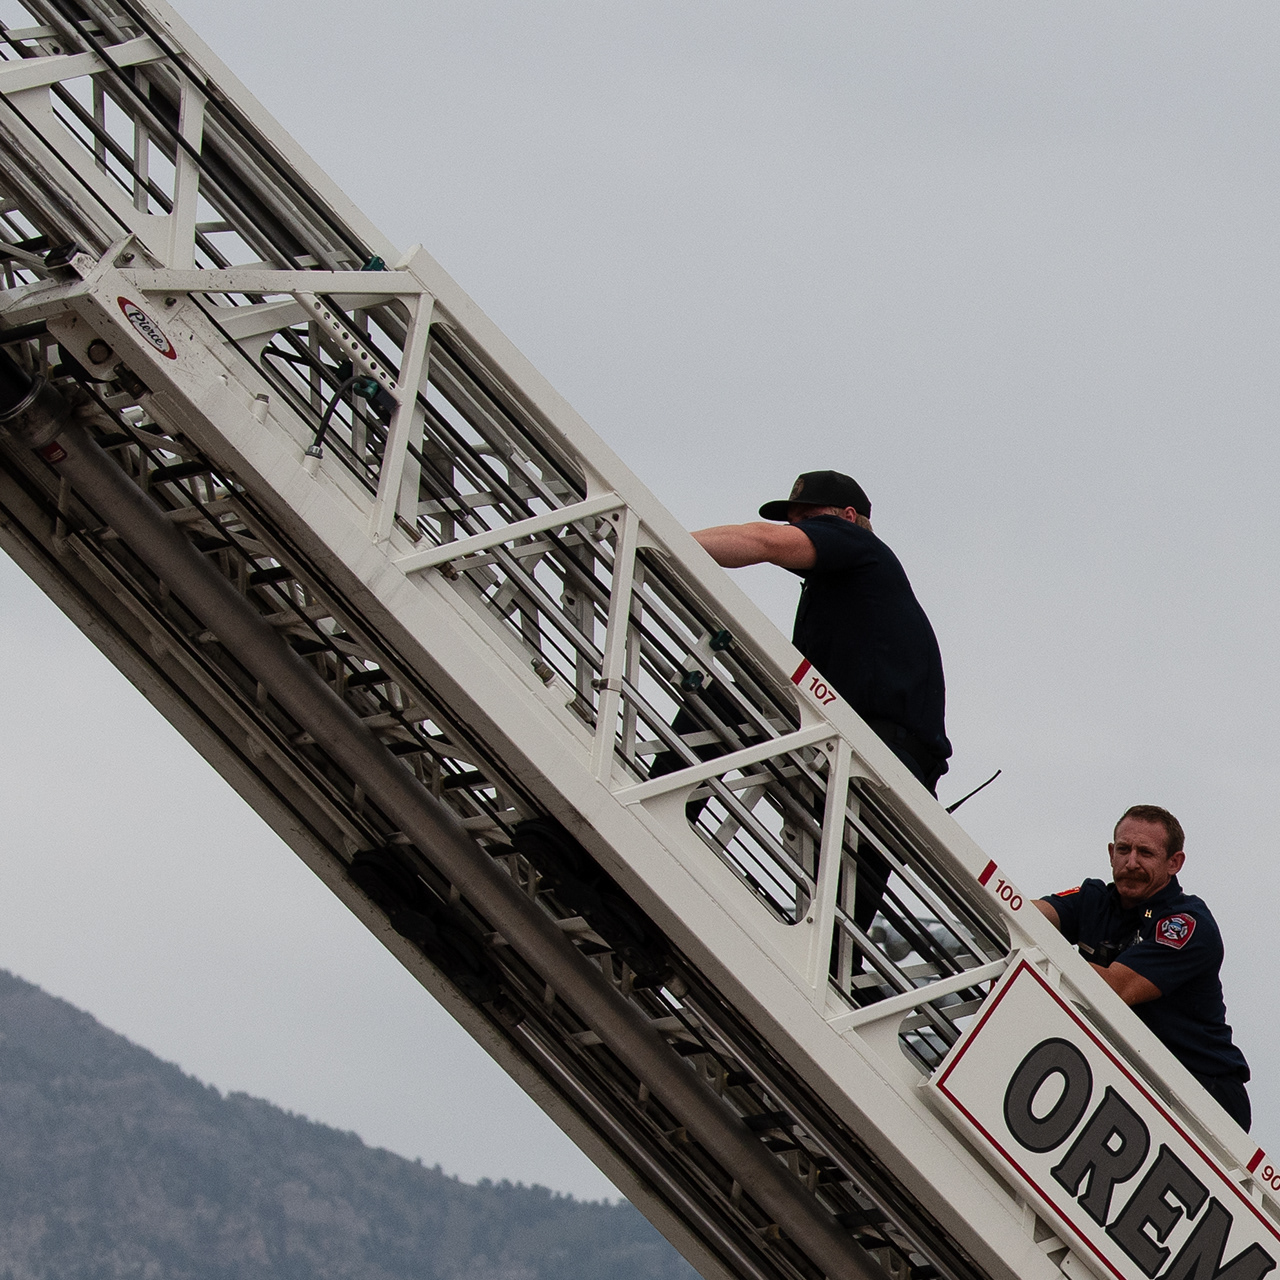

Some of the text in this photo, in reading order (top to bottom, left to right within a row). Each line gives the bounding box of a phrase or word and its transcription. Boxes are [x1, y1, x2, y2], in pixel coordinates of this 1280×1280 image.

[129, 309, 164, 346] Pierce
[809, 677, 837, 706] 107
[995, 879, 1023, 911] 100
